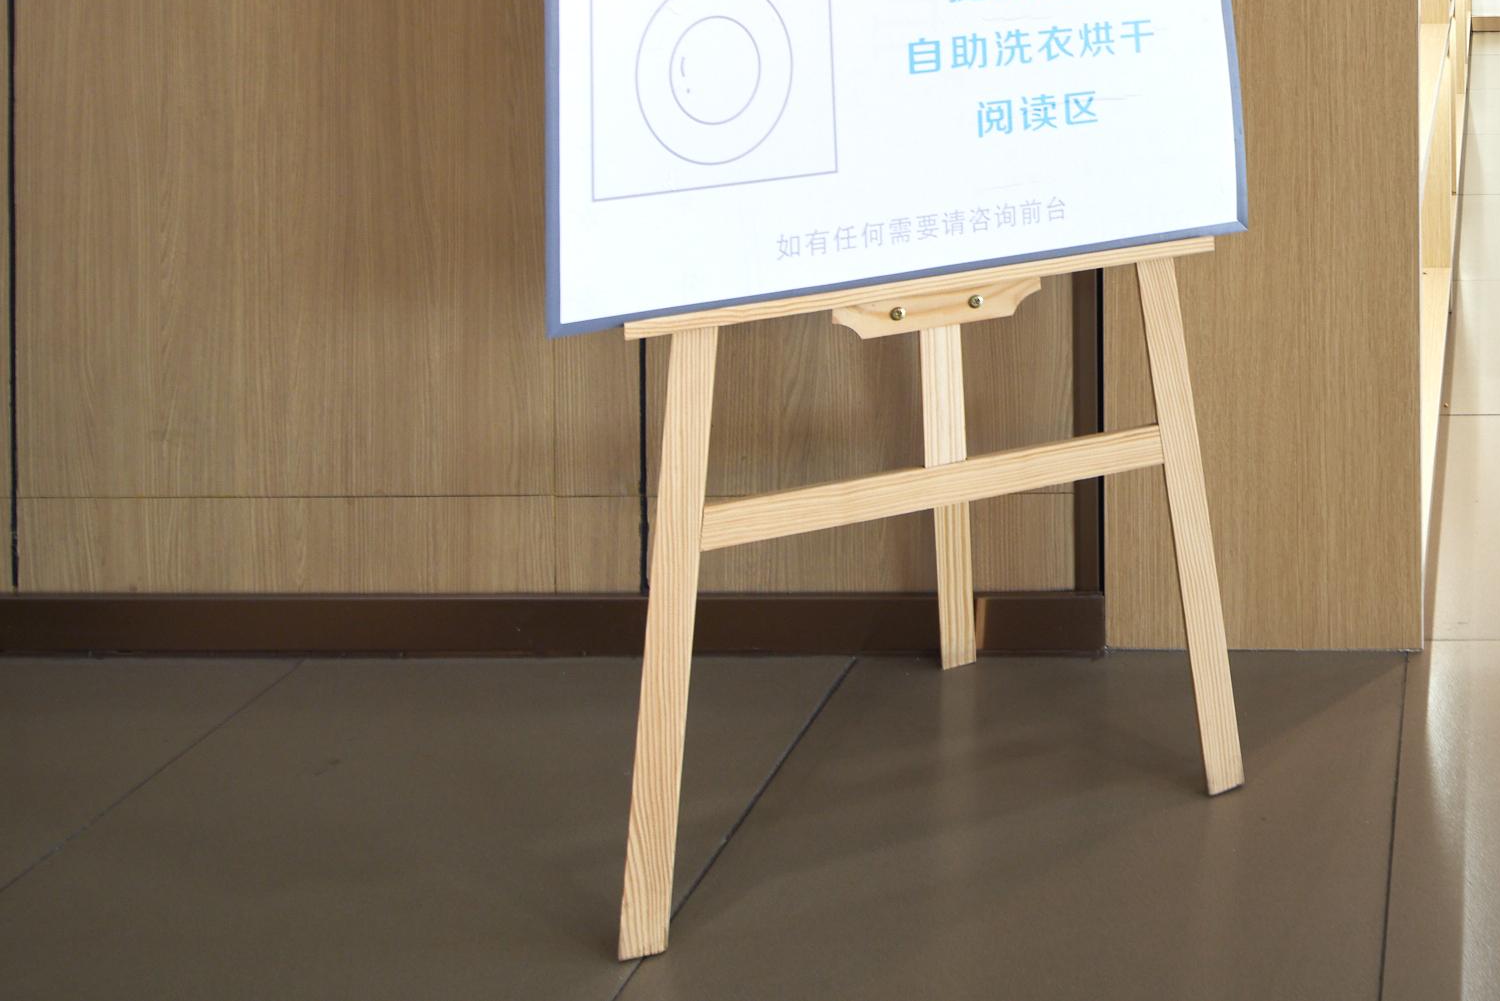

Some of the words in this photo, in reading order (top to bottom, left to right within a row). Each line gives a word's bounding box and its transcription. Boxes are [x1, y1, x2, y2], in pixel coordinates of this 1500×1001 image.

[907, 19, 1156, 75] 自助洗衣烘干
[977, 90, 1098, 138] 阅读区
[776, 195, 1067, 261] 如有任何需要请咨询前台
